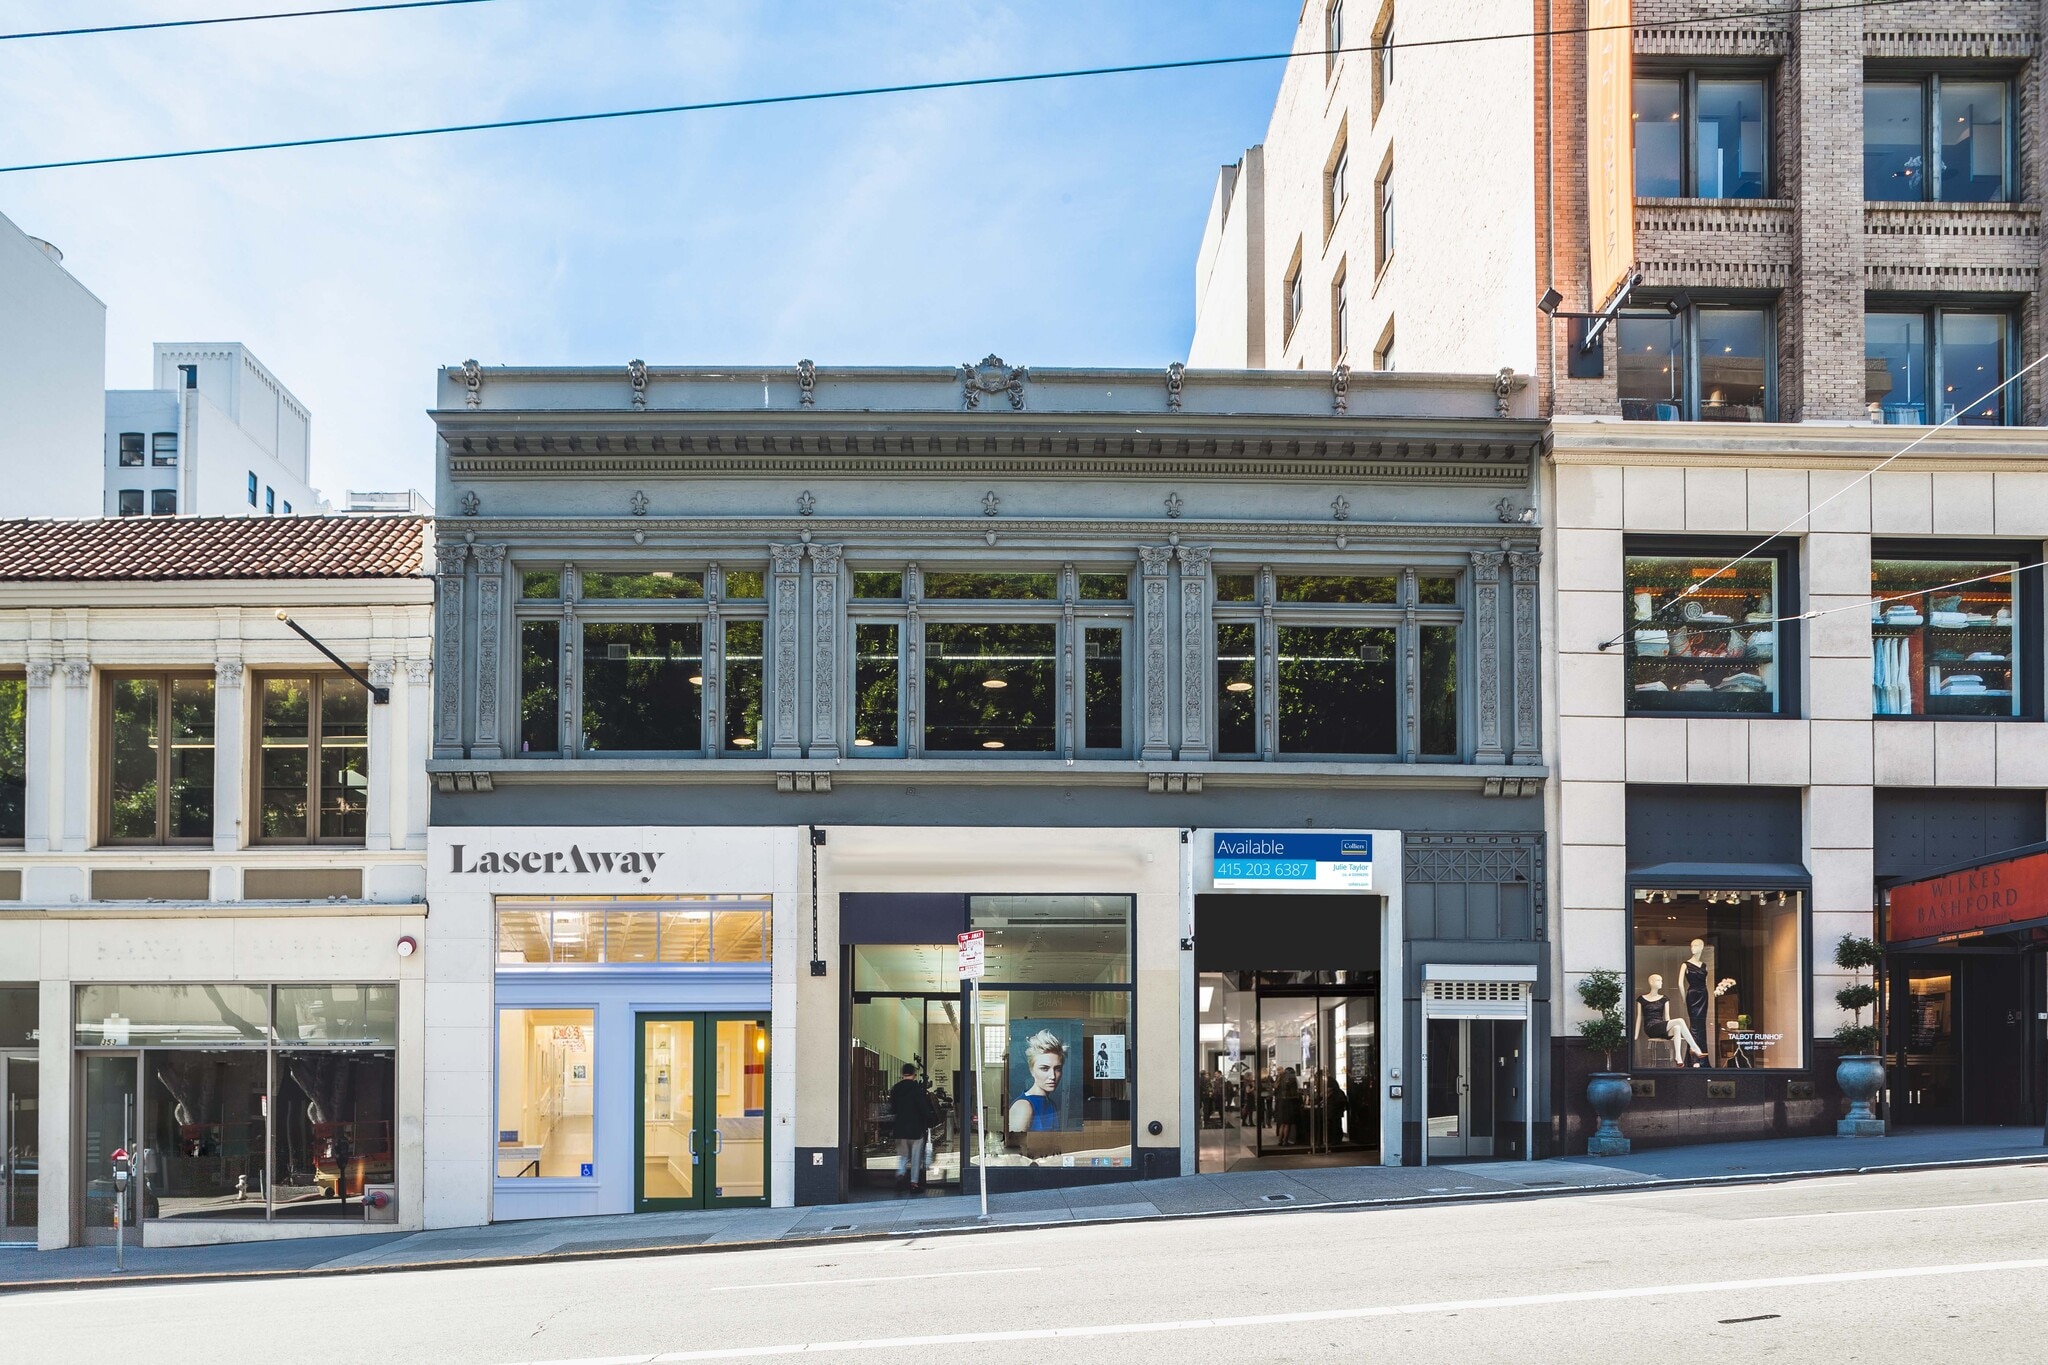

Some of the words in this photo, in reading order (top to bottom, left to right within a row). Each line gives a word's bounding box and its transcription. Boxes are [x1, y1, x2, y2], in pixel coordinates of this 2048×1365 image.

[1217, 839, 1284, 855] Available
[1344, 842, 1365, 850] Colliers
[450, 844, 665, 883] LaserAway
[1218, 863, 1242, 876] 415
[1246, 864, 1271, 877] 203
[1275, 864, 1308, 877] 6387
[1332, 864, 1347, 872] Julie
[1349, 864, 1369, 872] Taylor
[1931, 868, 2001, 899] WILKES
[1917, 888, 2018, 924] BASHFORD
